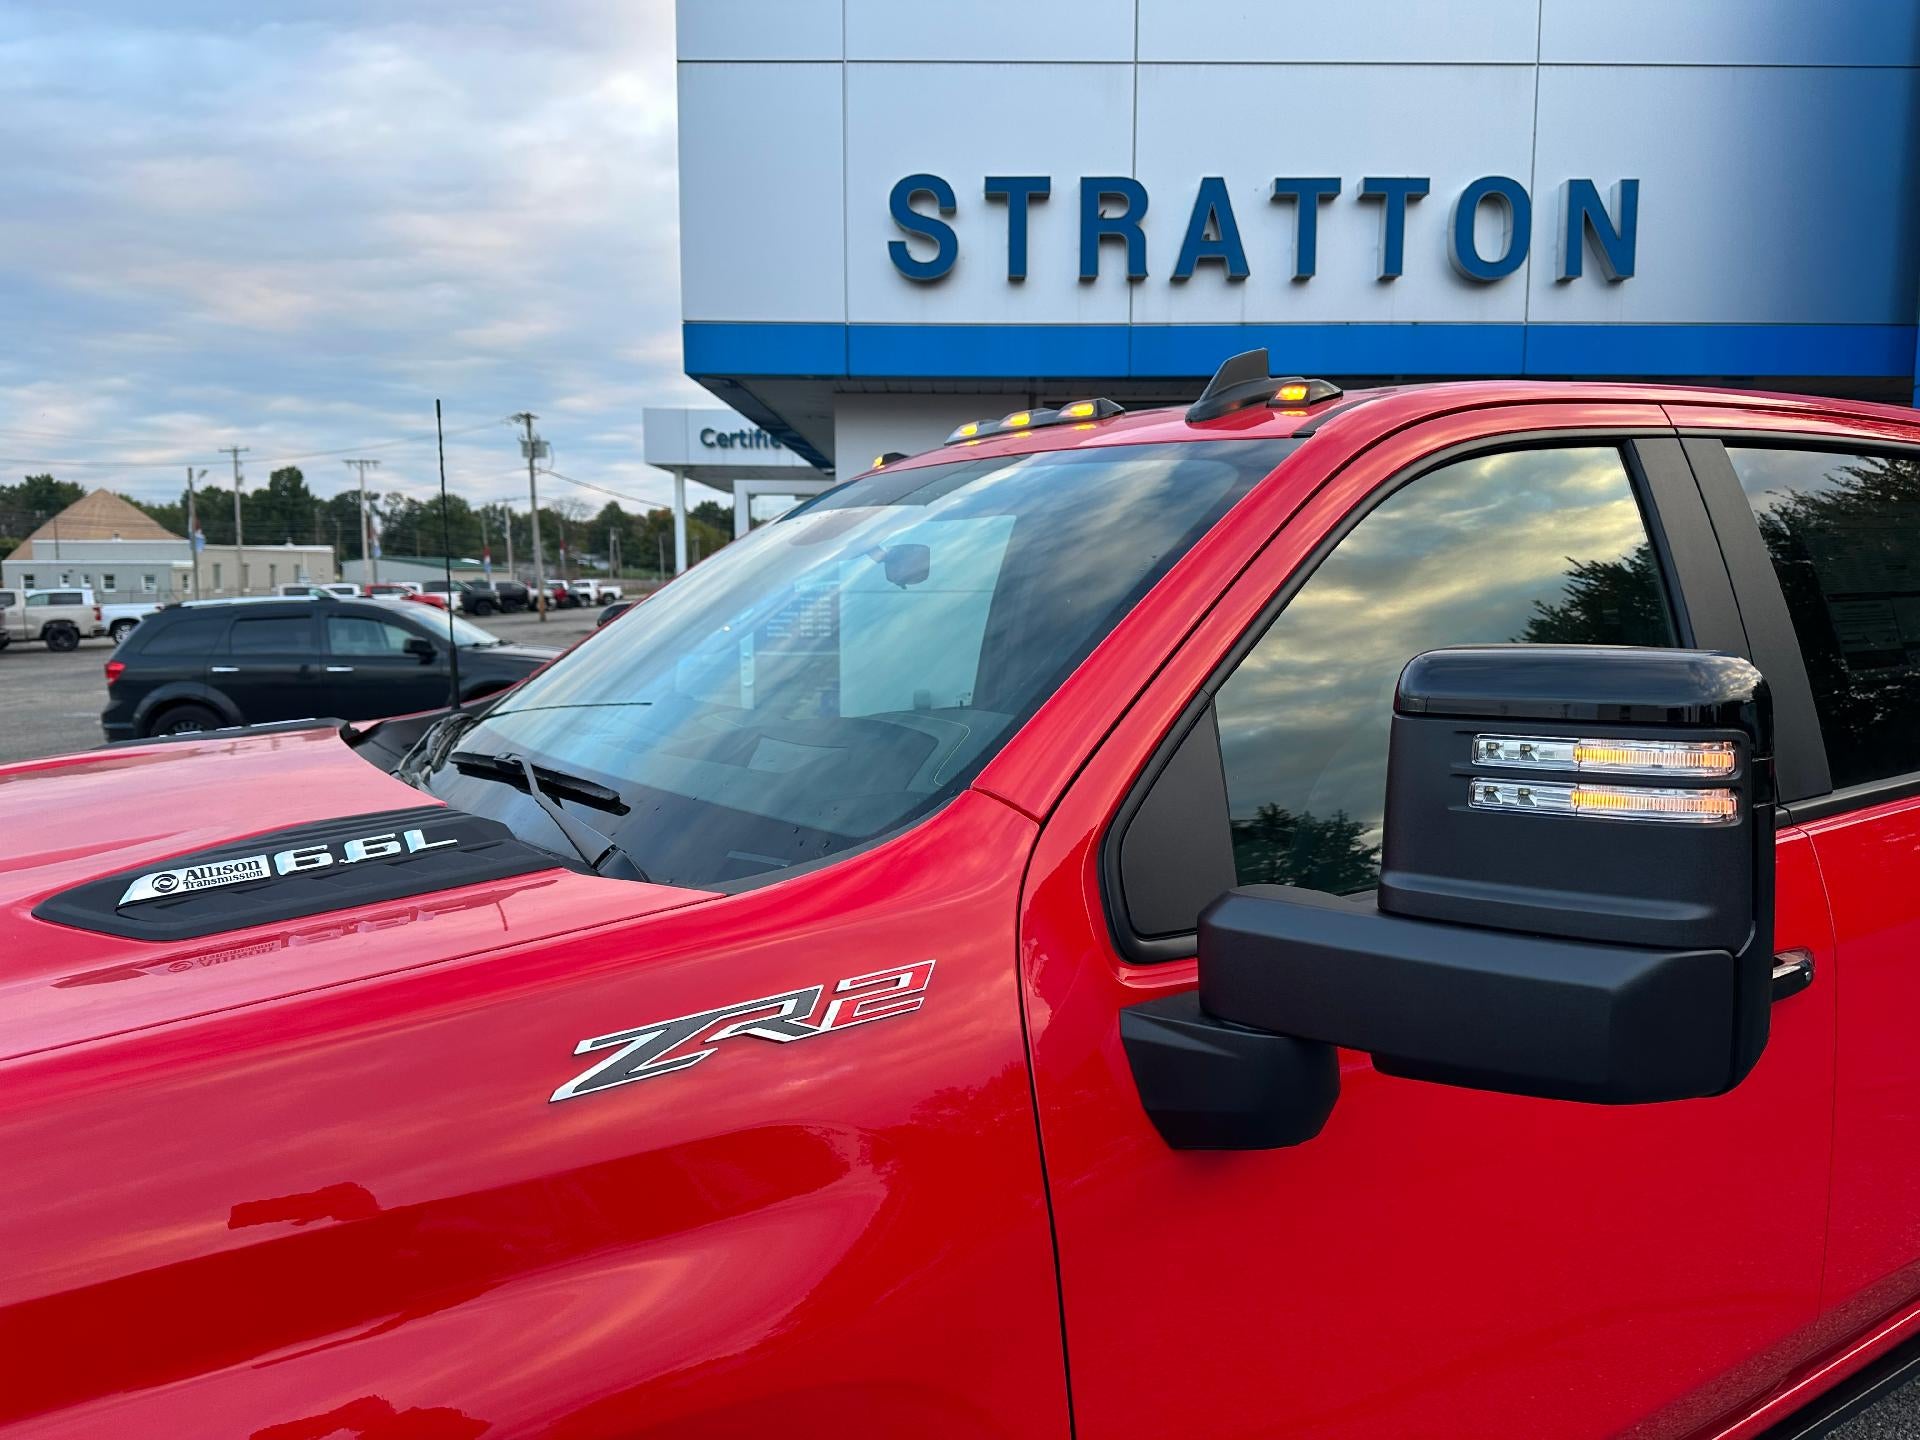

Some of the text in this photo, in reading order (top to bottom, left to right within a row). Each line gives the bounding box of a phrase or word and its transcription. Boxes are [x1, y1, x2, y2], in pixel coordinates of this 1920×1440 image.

[888, 173, 1640, 284] STRATTON
[184, 860, 262, 881] Allison
[273, 829, 458, 876] 6.6L
[182, 869, 264, 890] Transmission
[549, 959, 936, 1103] ZR2
